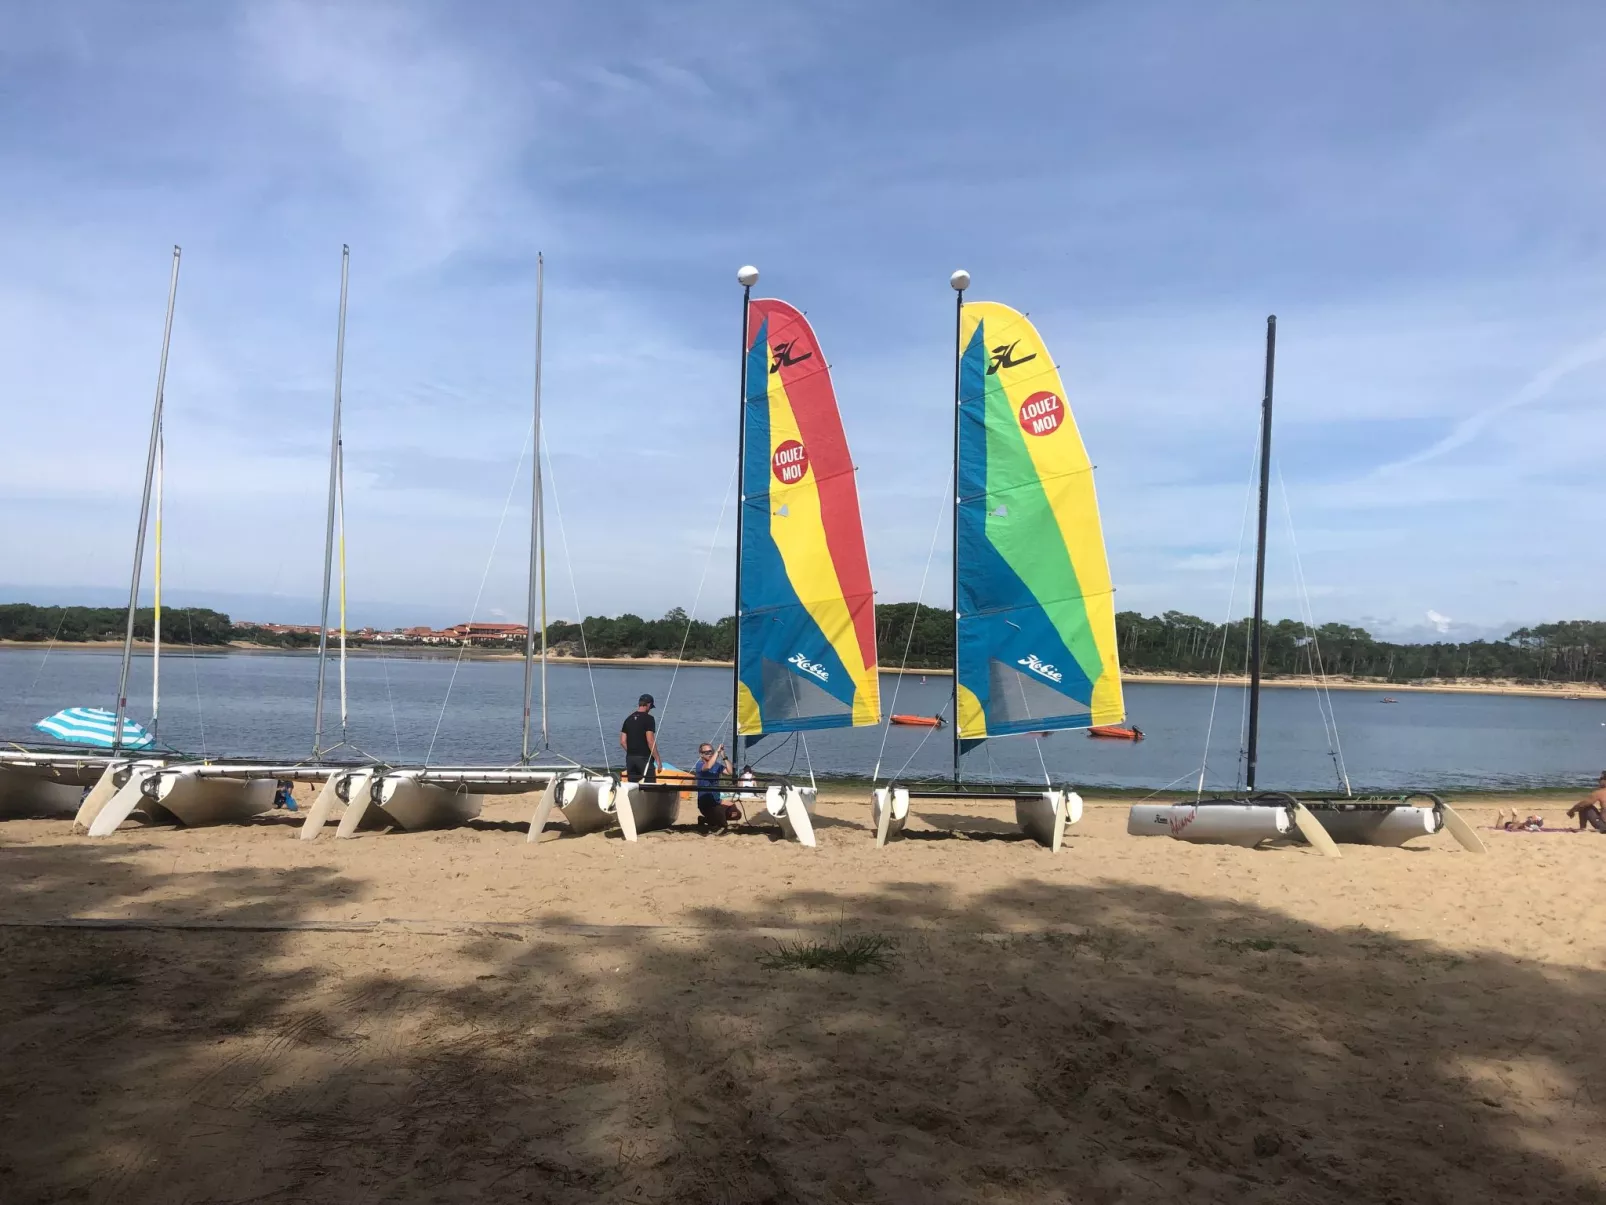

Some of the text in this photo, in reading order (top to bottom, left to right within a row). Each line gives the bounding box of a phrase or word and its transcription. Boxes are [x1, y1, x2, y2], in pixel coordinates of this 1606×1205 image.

[1021, 395, 1059, 420] LOUEZ
[1032, 414, 1057, 434] MOI
[775, 446, 805, 466] LOUEZ
[782, 464, 802, 481] MOI
[787, 652, 829, 683] Hobie
[1017, 653, 1062, 683] Hobie
